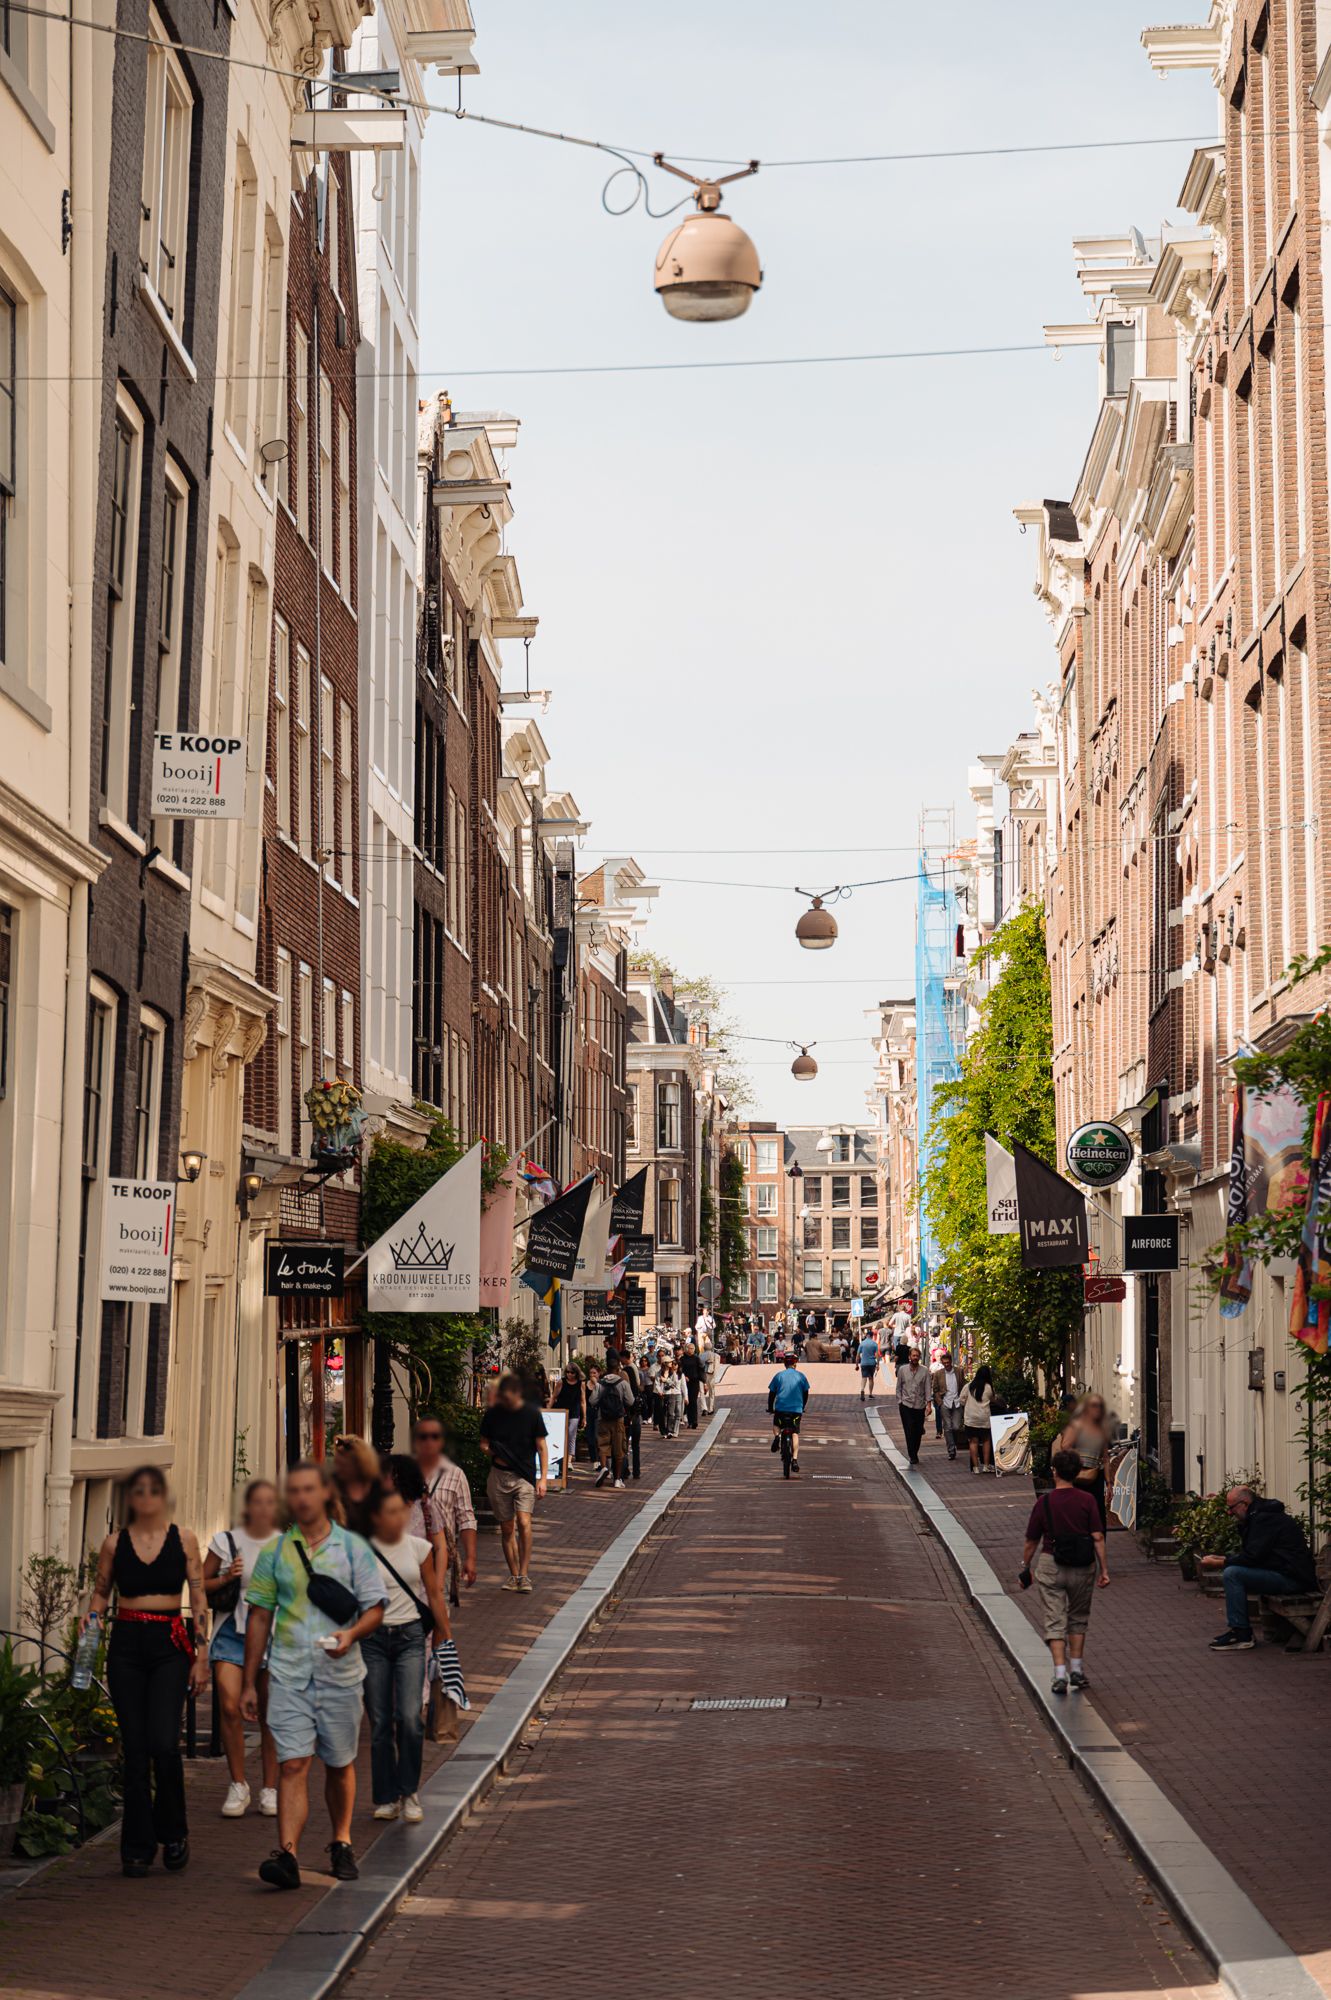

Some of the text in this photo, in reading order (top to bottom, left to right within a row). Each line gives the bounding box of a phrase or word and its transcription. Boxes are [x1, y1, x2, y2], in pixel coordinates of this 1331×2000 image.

[180, 736, 242, 755] KOOP
[163, 761, 213, 786] booij
[157, 794, 180, 804] (020)
[209, 798, 226, 806] 888
[164, 807, 217, 816] www.booijoz.nl
[1071, 1148, 1126, 1160] Heineken
[112, 1185, 172, 1200] TE KOOP
[1030, 1218, 1074, 1236] MAX
[120, 1223, 162, 1248] booij
[531, 1233, 577, 1250] TESSA KOOPS
[1132, 1238, 1172, 1248] AIRFORCE
[277, 1254, 294, 1276] Le
[531, 1256, 567, 1271] BOUTIQUE
[110, 1265, 129, 1274] (020)
[138, 1268, 151, 1276] 222
[154, 1269, 167, 1277] 888
[281, 1281, 294, 1289] hair
[303, 1282, 332, 1291] make-up
[373, 1274, 471, 1285] KROONJUWEELTJES
[109, 1284, 166, 1295] www.booijoz.nl
